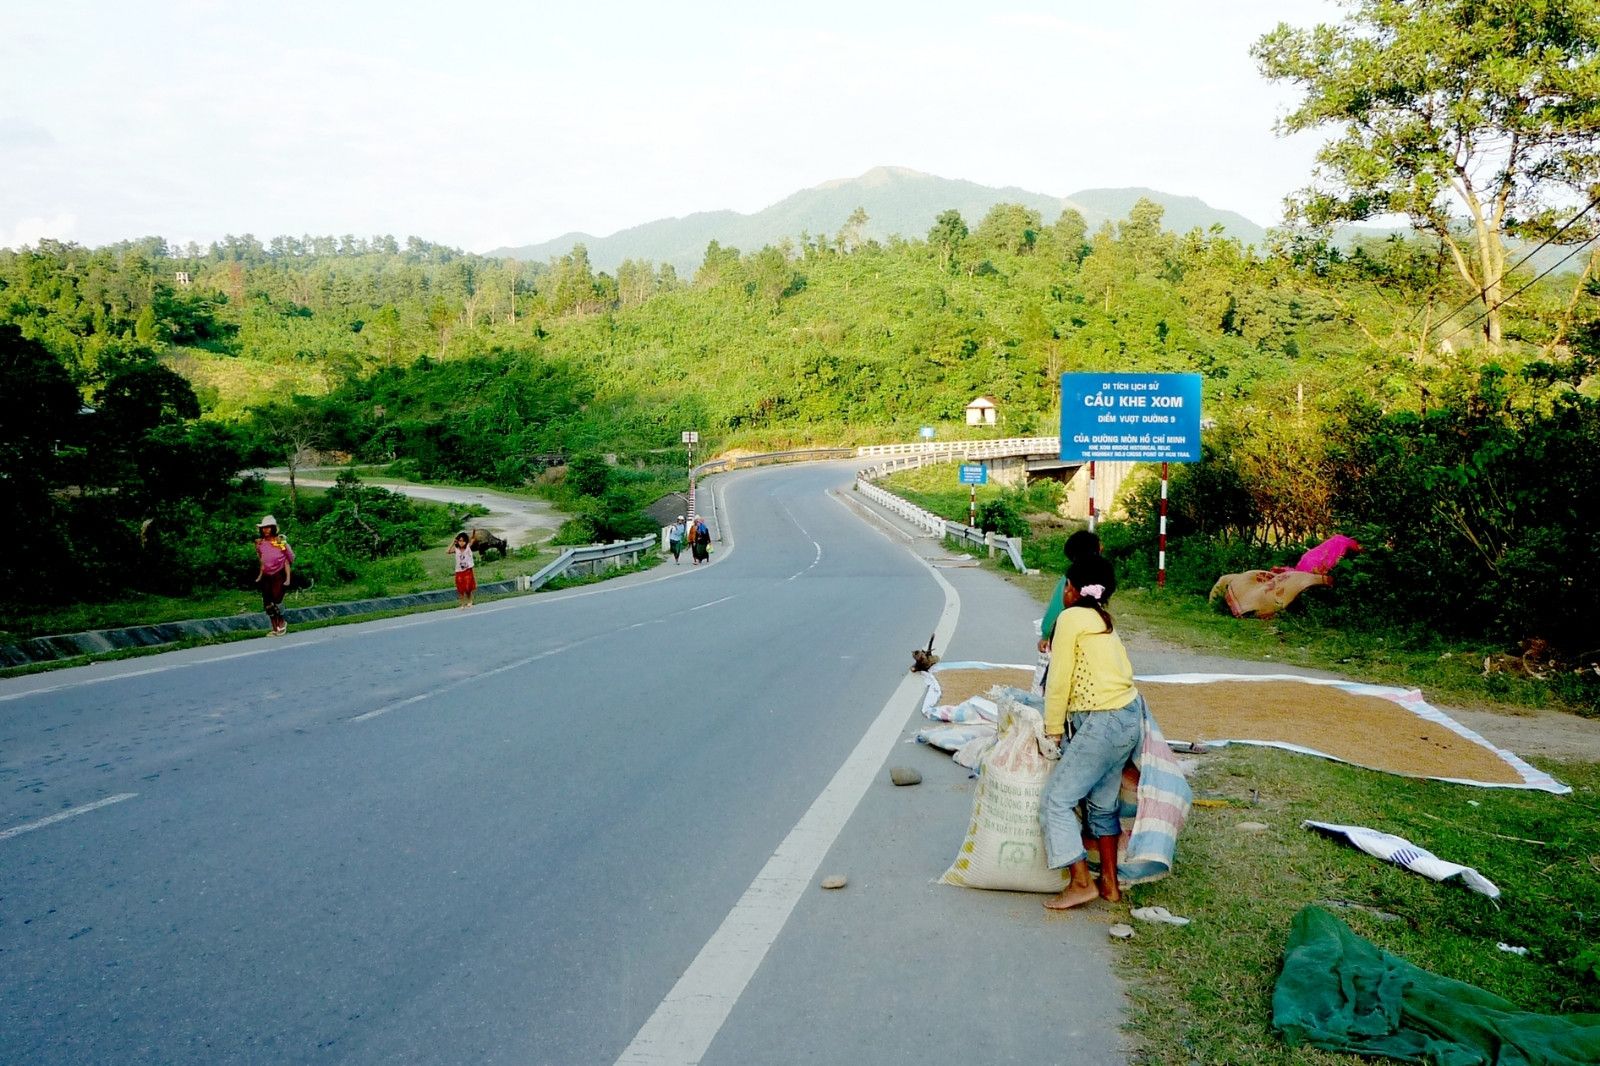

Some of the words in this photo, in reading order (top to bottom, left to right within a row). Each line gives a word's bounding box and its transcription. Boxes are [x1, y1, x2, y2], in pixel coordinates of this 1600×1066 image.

[1113, 382, 1128, 390] TÍCH
[1131, 383, 1146, 391] LỊCH
[1084, 391, 1114, 407] CẦU
[1119, 396, 1146, 407] KHE
[1151, 396, 1183, 407] XOM
[1167, 436, 1186, 444] MINH
